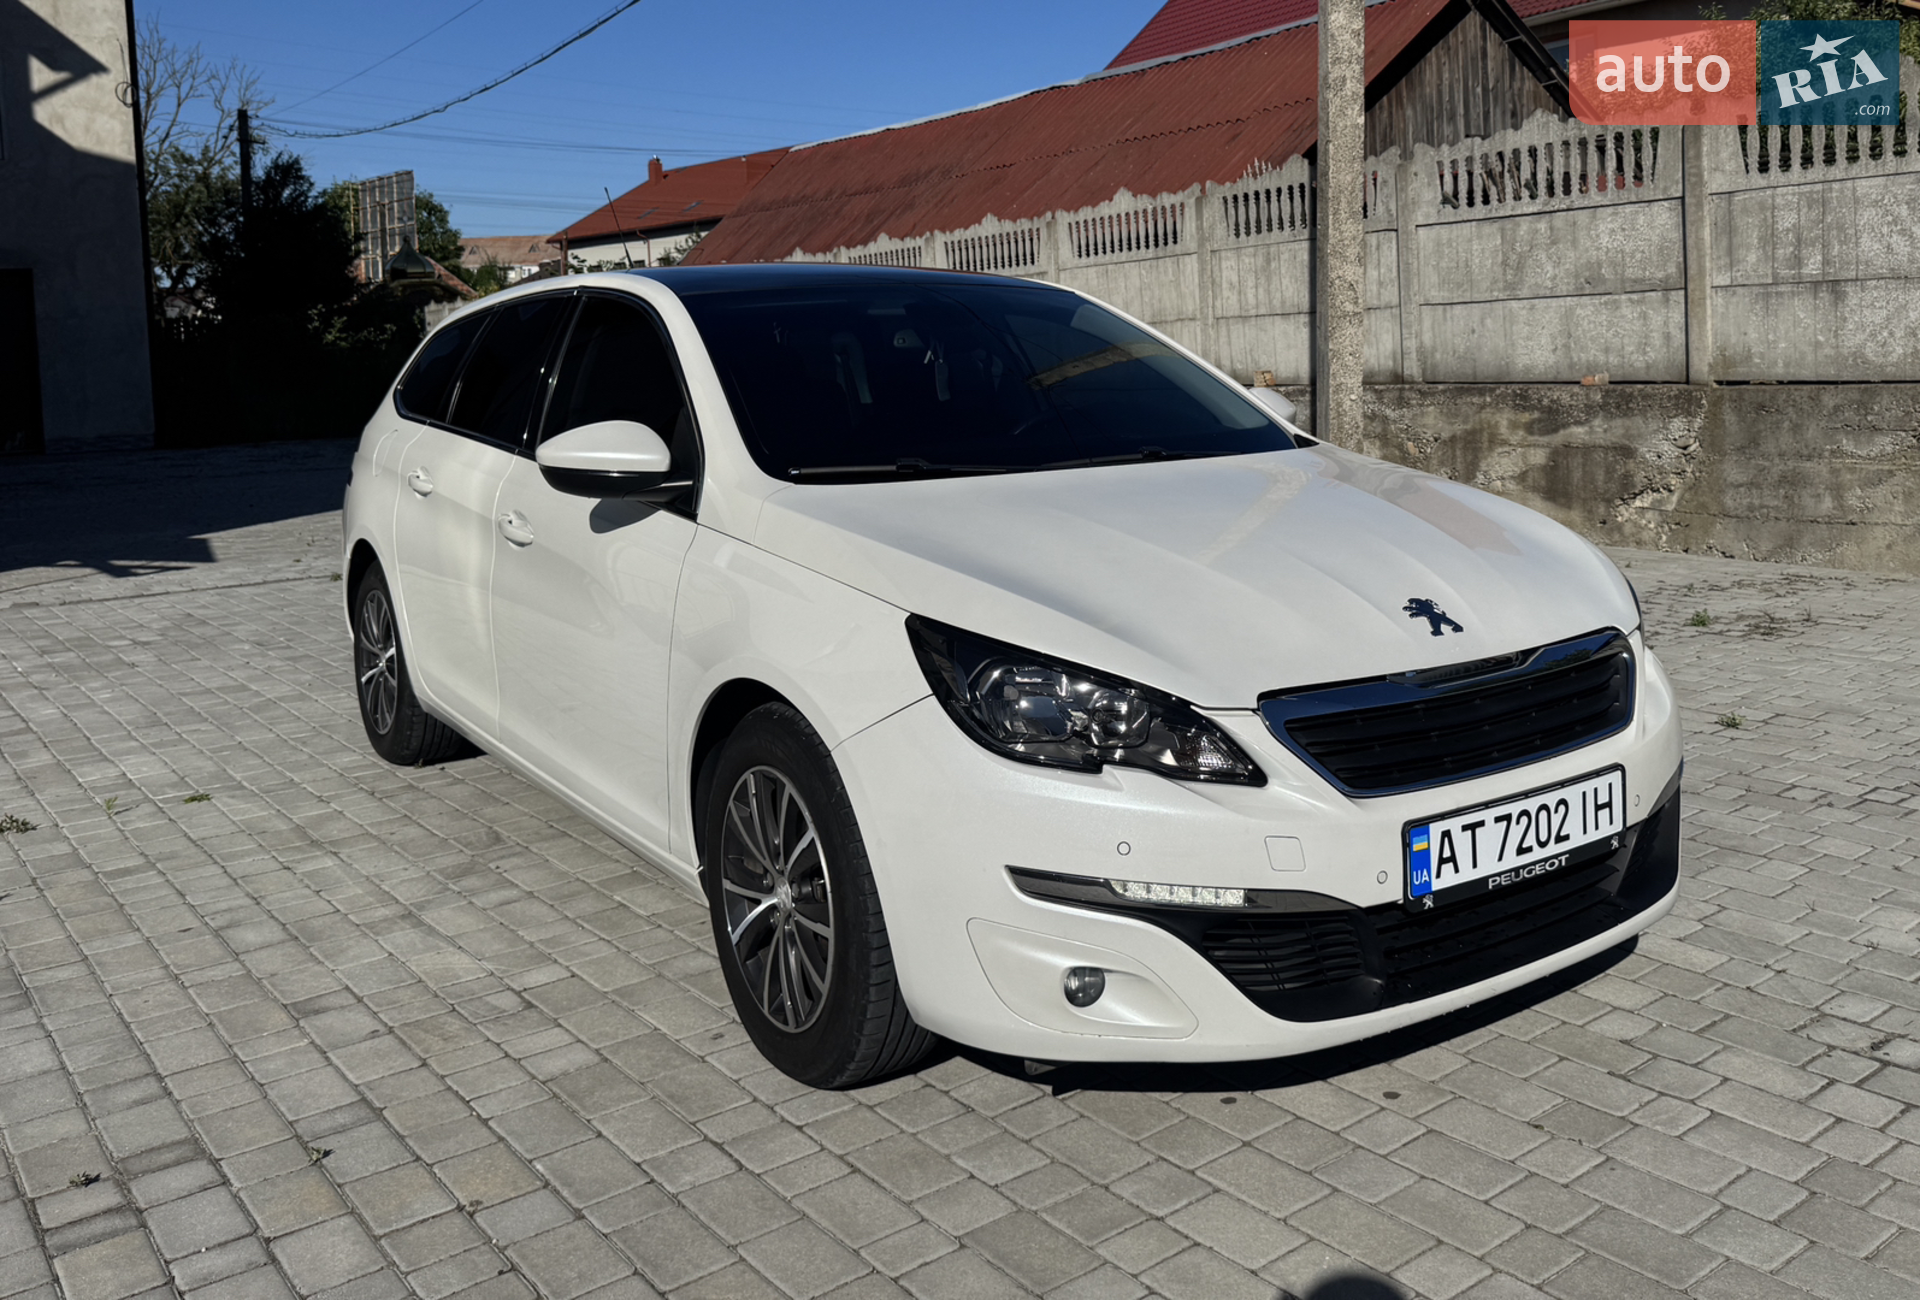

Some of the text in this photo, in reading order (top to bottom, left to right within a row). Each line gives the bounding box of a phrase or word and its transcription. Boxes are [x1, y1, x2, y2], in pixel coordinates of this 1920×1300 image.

[1435, 782, 1614, 879] AT 7202 IH
[1413, 869, 1430, 885] UA
[1488, 854, 1569, 889] PEUGEOT
